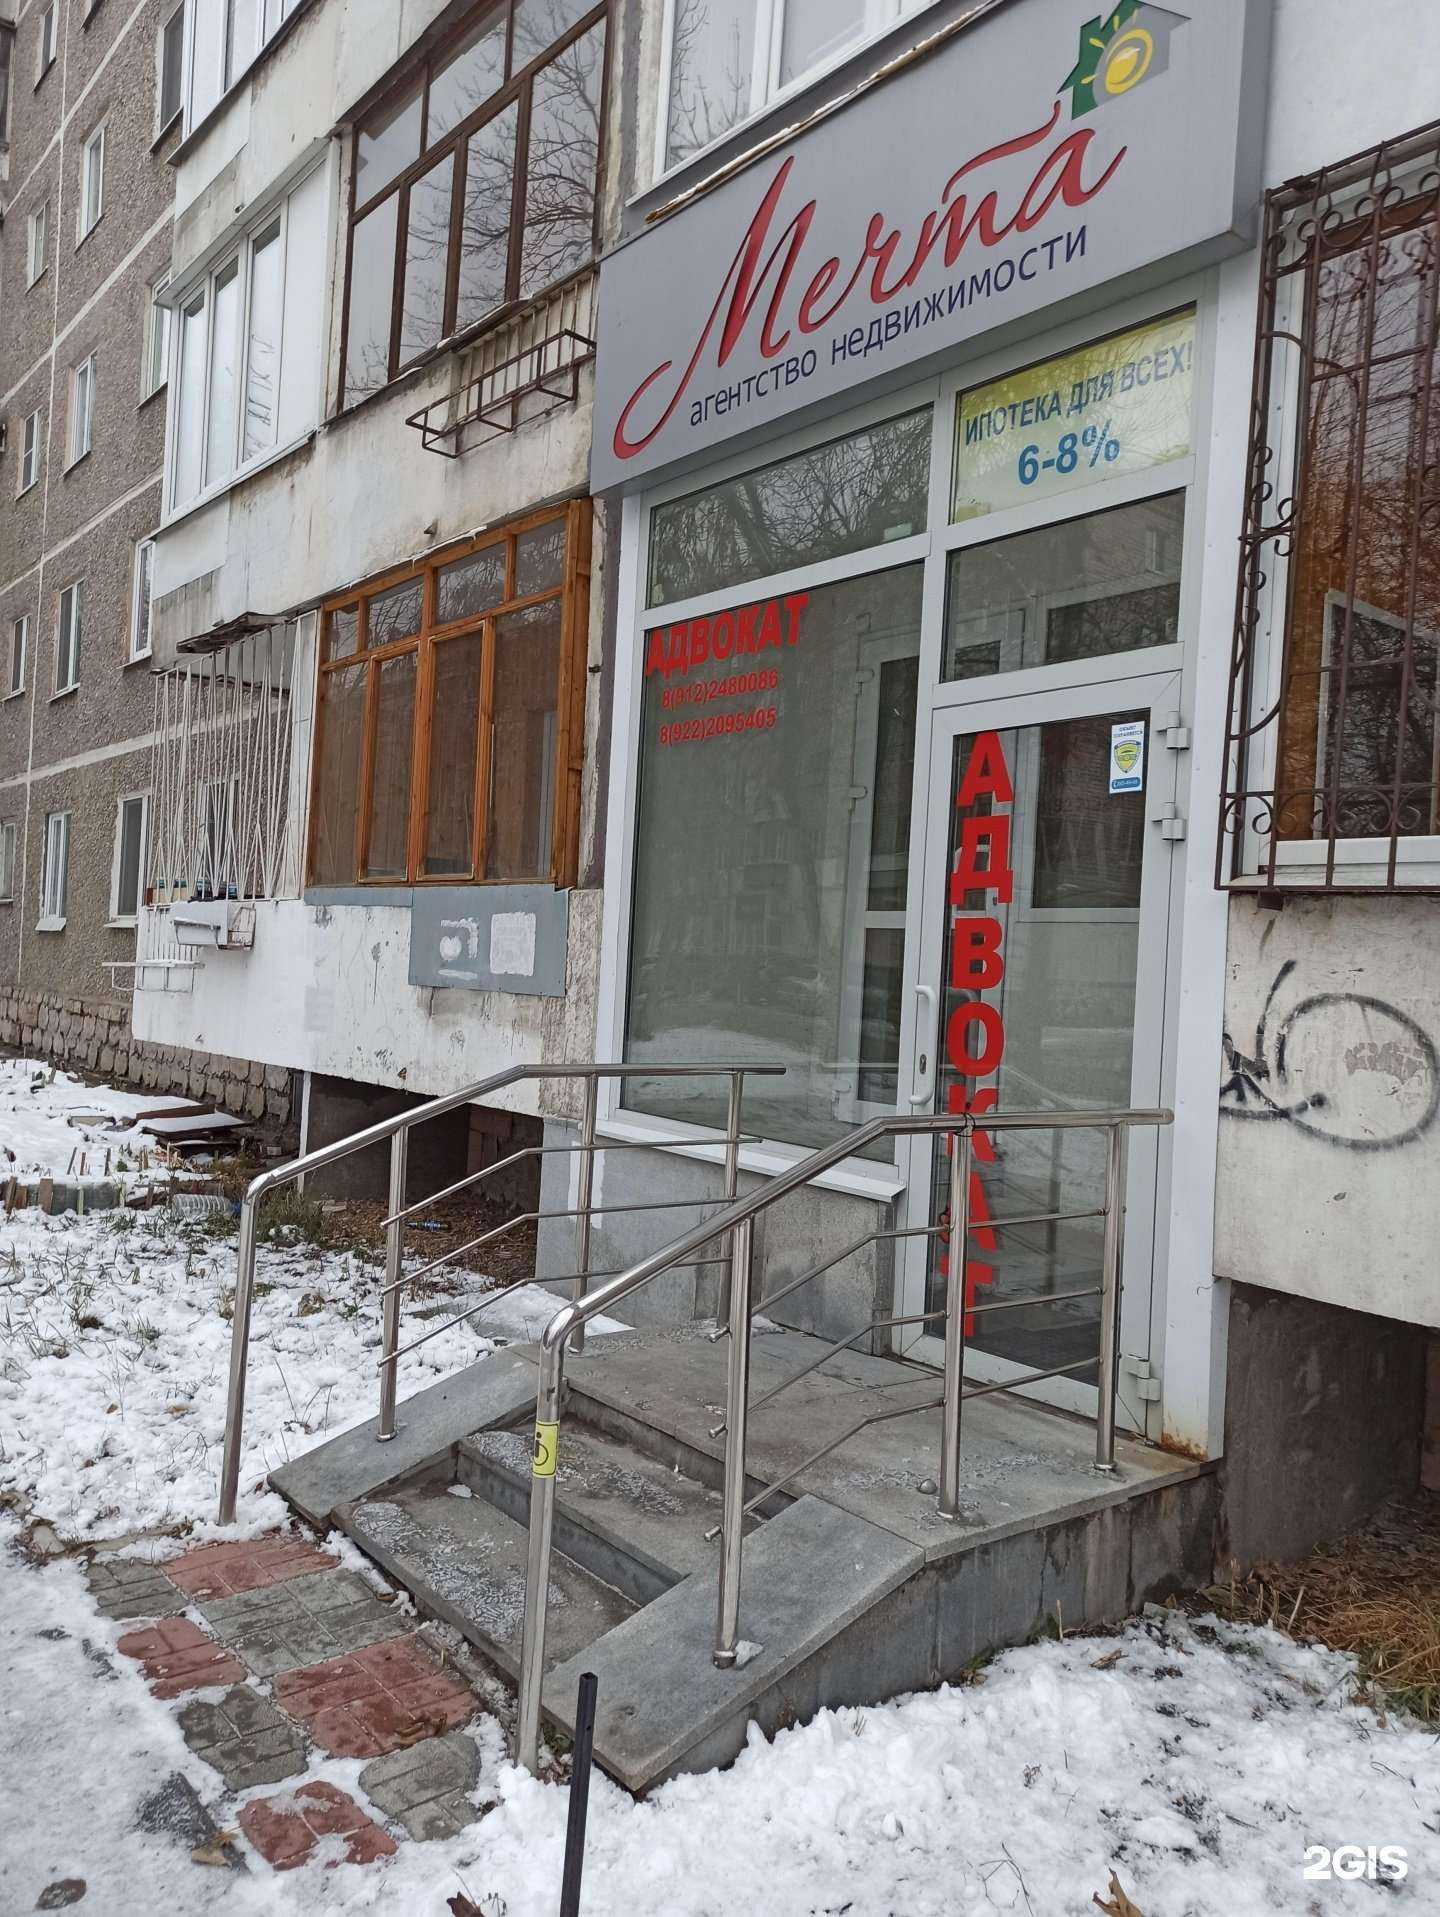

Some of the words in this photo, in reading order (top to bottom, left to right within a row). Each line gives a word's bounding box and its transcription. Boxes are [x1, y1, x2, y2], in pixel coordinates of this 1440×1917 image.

[613, 100, 1127, 460] Мечта
[690, 350, 817, 426] агентство
[831, 225, 1087, 366] недвижимости
[965, 391, 1061, 445] ИПОТЕКА
[1067, 370, 1113, 418] ДЛЯ
[1120, 341, 1192, 393] ВСЕХ!
[1018, 418, 1120, 486] 6-8%
[645, 594, 808, 679] АДВОКАТ
